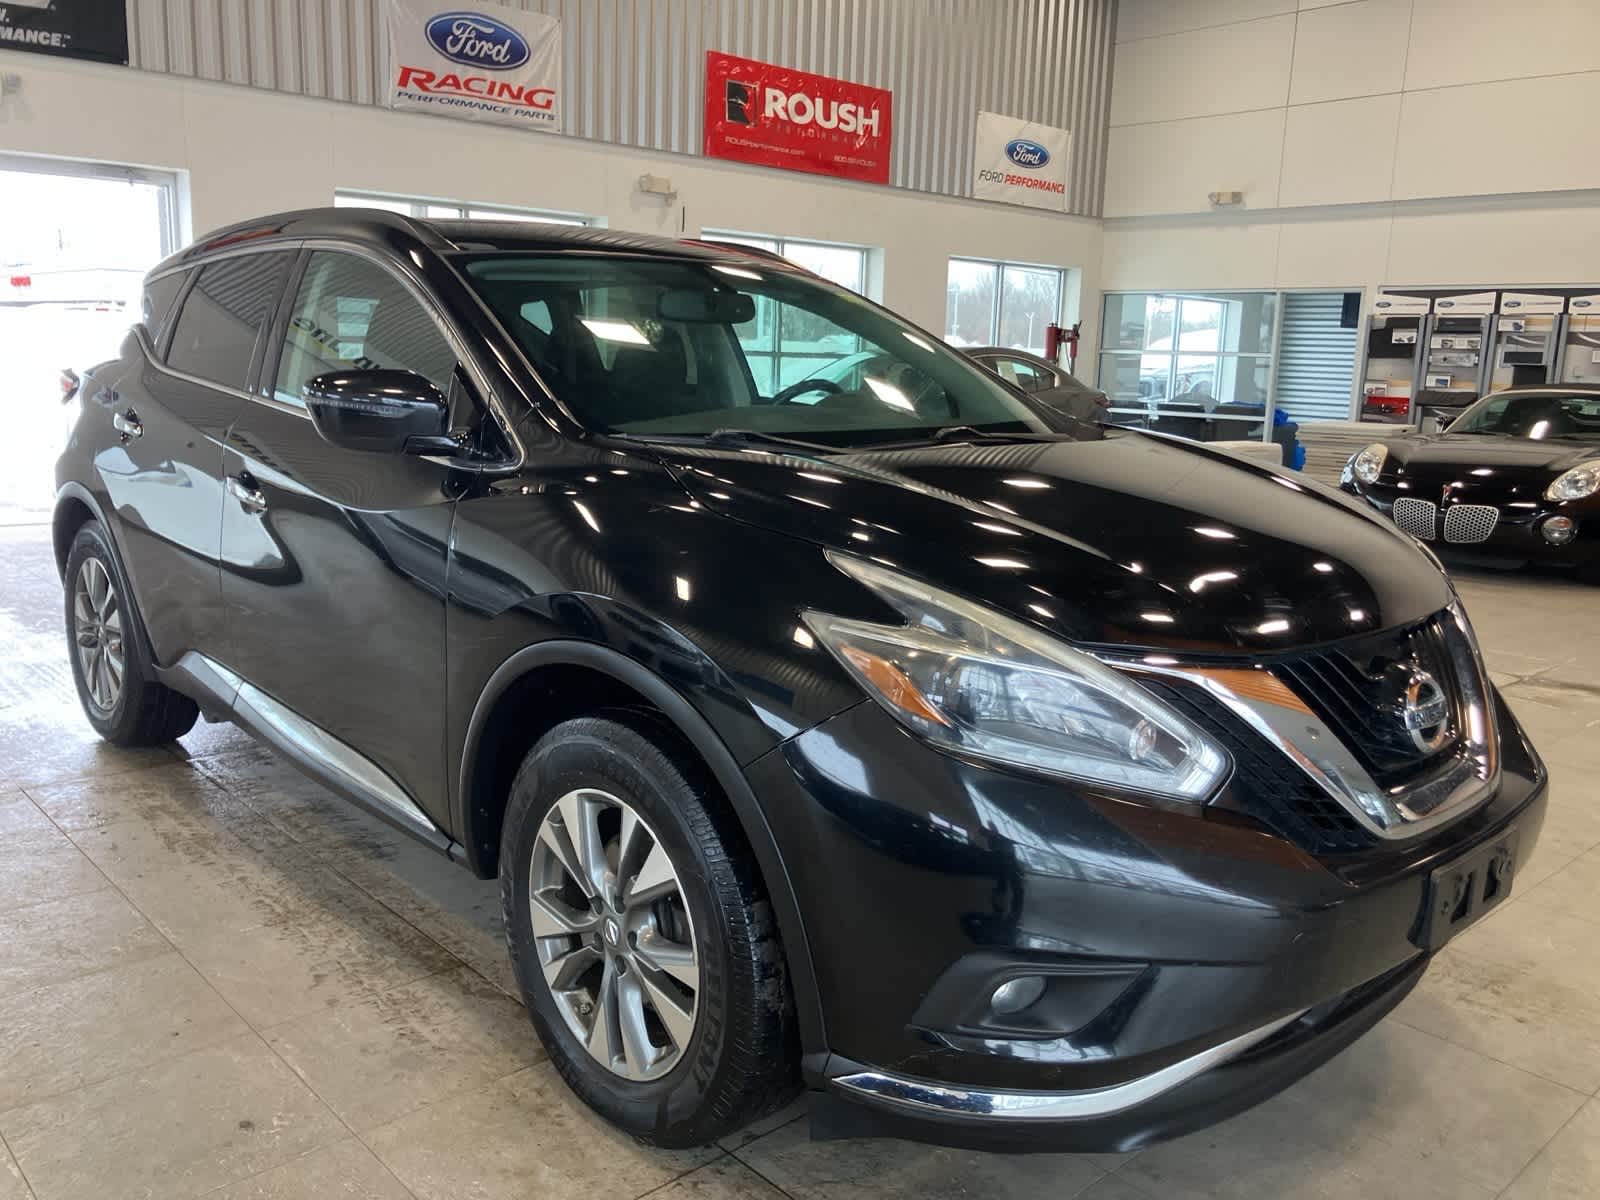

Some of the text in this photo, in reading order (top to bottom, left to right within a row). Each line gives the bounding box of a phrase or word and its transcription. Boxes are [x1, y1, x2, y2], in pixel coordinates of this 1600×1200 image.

[446, 19, 511, 63] Ford
[396, 91, 555, 121] PERFORMANCE PARTS
[397, 65, 556, 110] RACING
[765, 87, 880, 138] ROUSH
[1013, 143, 1041, 164] Ford
[979, 169, 1004, 183] FORD
